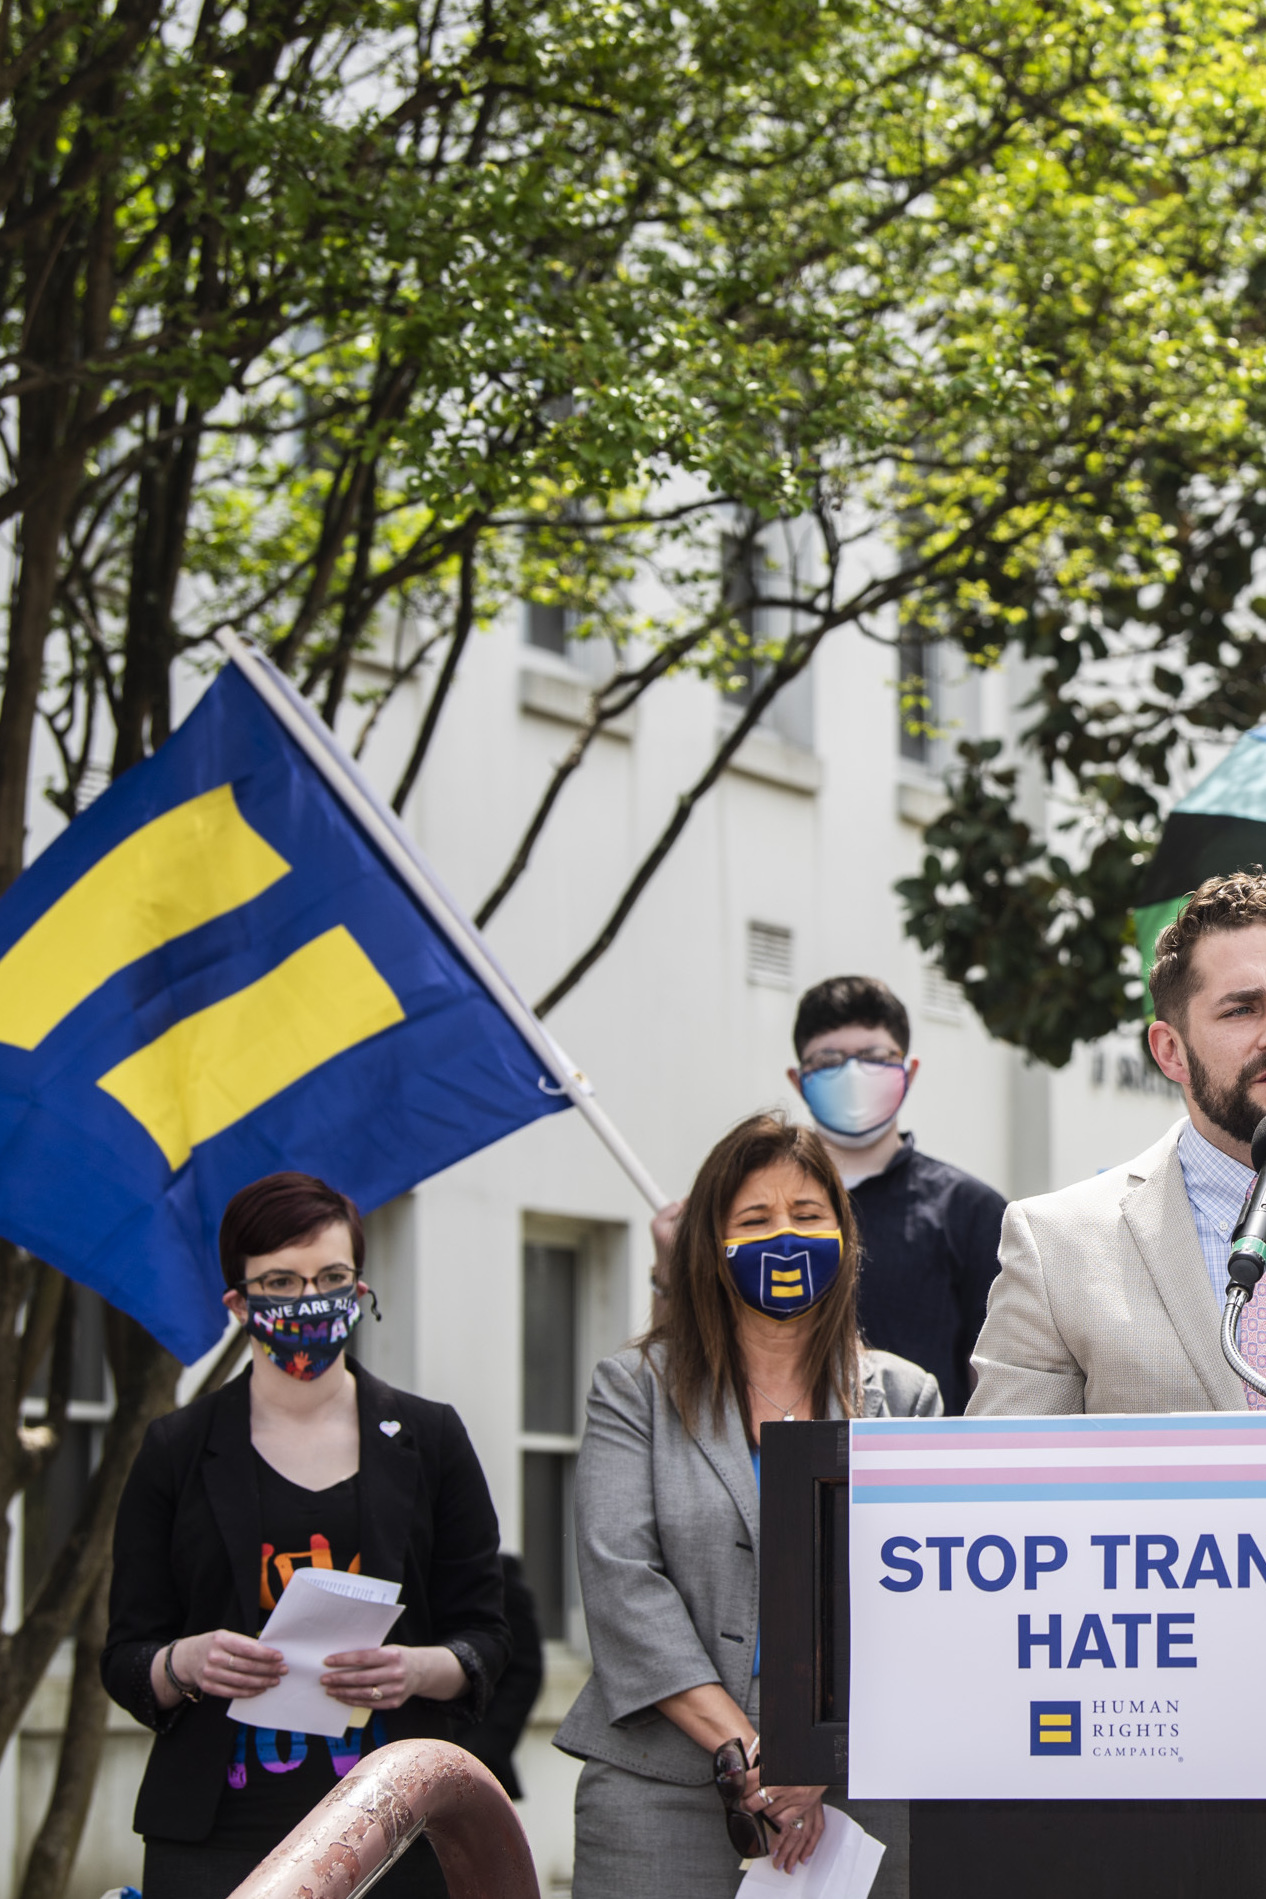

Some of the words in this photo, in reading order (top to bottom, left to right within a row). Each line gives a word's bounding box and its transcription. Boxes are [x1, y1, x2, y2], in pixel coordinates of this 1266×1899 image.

[254, 1301, 360, 1346] HUMAN
[265, 1305, 293, 1319] WE
[298, 1300, 330, 1316] ARE
[879, 1534, 1068, 1593] STOP
[1017, 1612, 1198, 1669] HATE
[1091, 1700, 1180, 1714] HUMAN
[1091, 1723, 1180, 1738] RIGHTS
